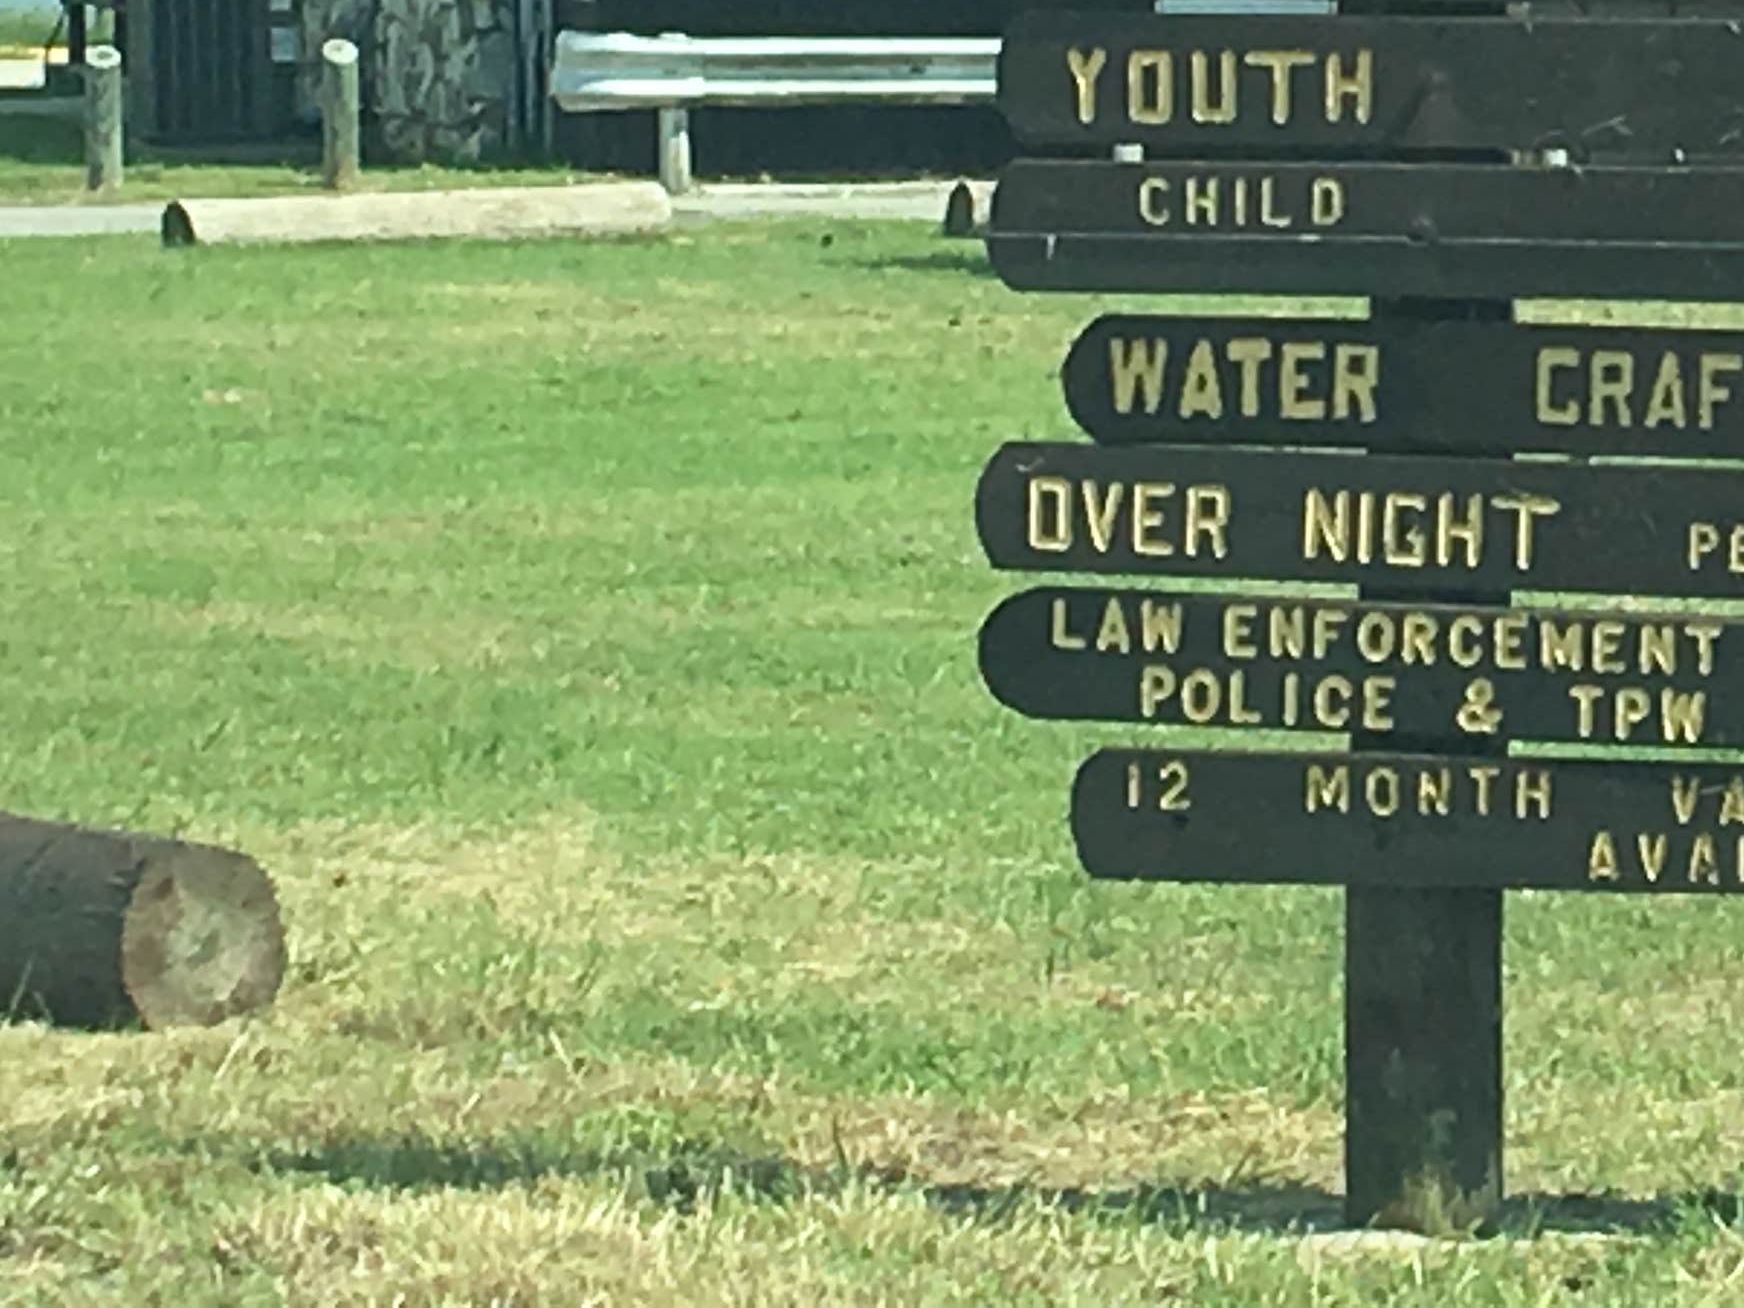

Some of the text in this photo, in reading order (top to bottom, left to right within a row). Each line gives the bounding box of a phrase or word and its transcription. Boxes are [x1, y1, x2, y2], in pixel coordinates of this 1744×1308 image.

[1066, 48, 1374, 126] YOUTH
[1139, 176, 1344, 228] CHILD
[1110, 337, 1379, 423] WATER
[1028, 476, 1231, 560] OVER
[1304, 488, 1561, 571] NIGHT
[1052, 598, 1183, 655] LAW
[1223, 605, 1723, 676] ENFORCEMENT
[1140, 665, 1396, 731] POLICE
[1455, 678, 1502, 733] &
[1568, 685, 1706, 742] TPW
[1126, 764, 1192, 811] 12
[1305, 766, 1551, 819] MONTH
